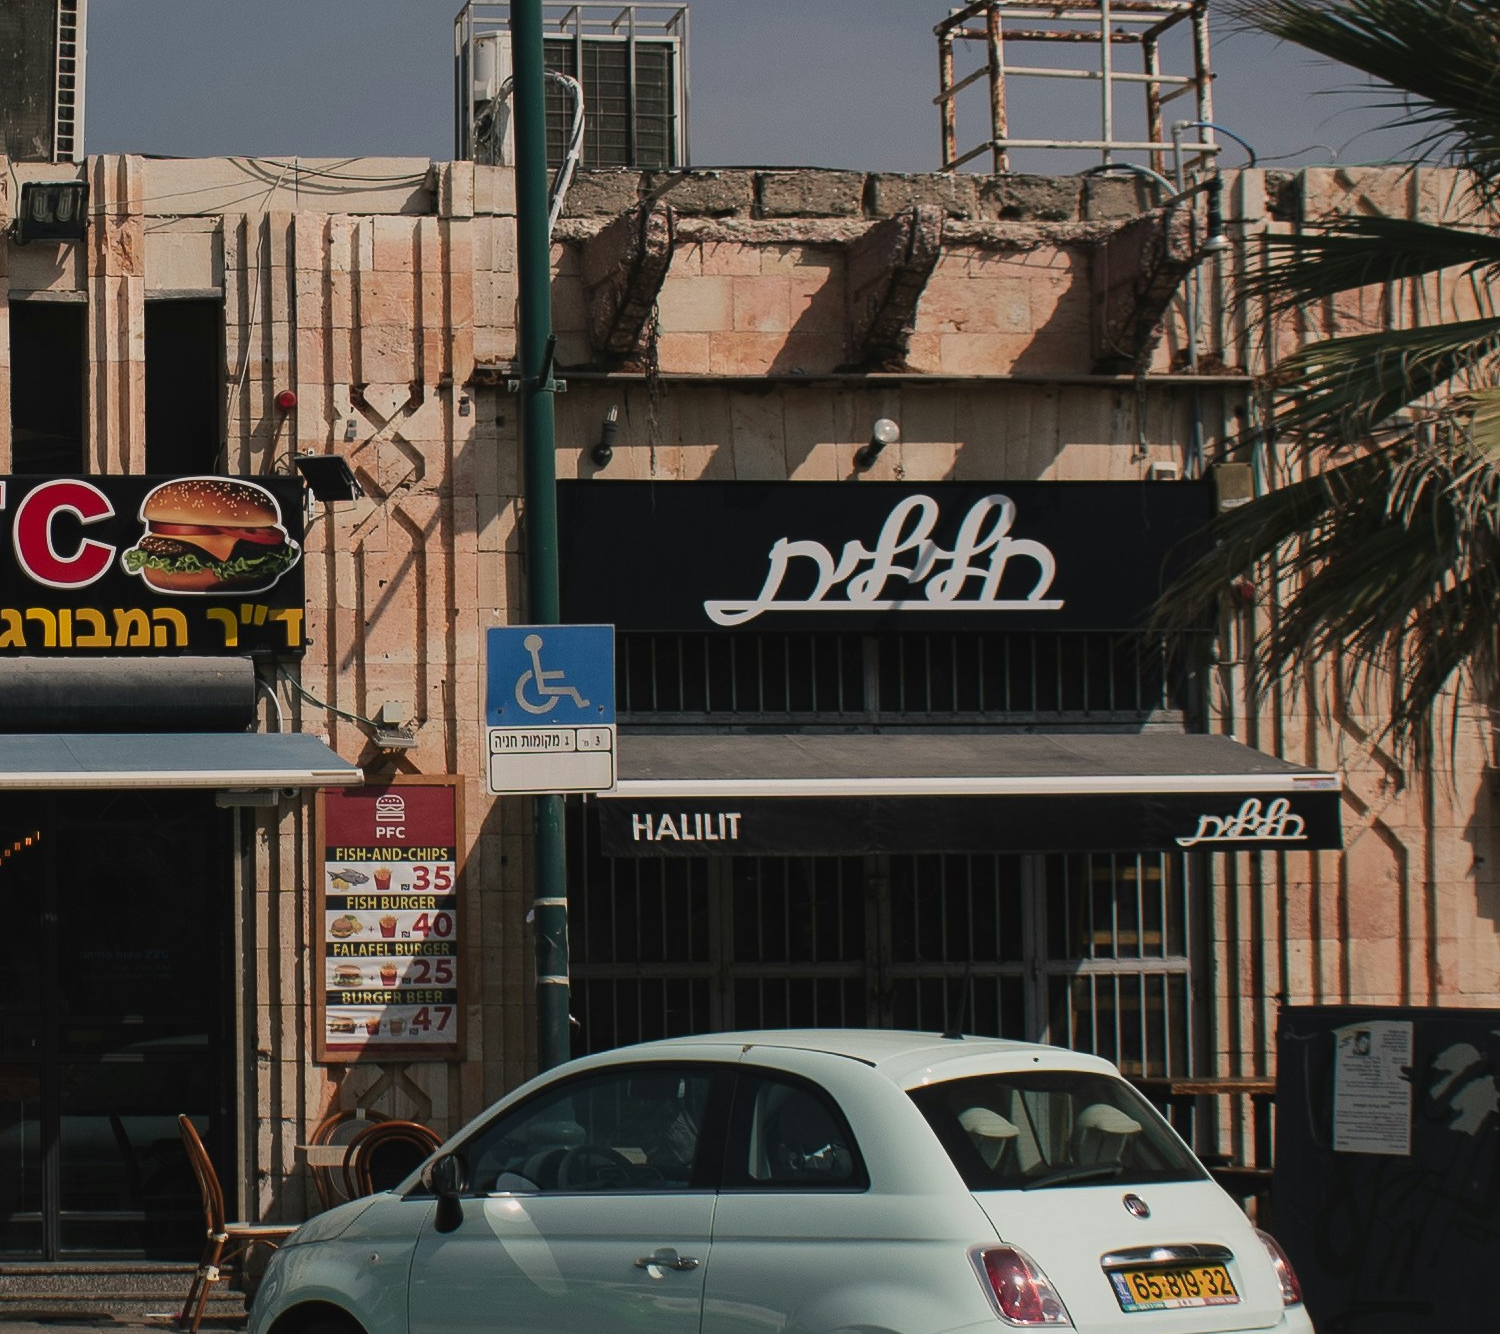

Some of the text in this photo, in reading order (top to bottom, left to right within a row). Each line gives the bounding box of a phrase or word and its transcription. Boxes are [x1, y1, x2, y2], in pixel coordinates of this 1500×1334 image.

[494, 734, 518, 748] חניה
[521, 734, 560, 749] מקומות
[376, 826, 406, 839] PFC
[632, 812, 741, 842] HALILIT
[336, 847, 448, 861] FISH-AND-CHIPS
[412, 865, 452, 891] 35
[346, 896, 436, 909] FISH BURGER
[412, 912, 453, 938] 40
[333, 942, 450, 957] FALAFEL BURGER
[412, 958, 454, 984] 25
[341, 990, 443, 1004] BURGER BEER
[411, 1006, 453, 1031] 47
